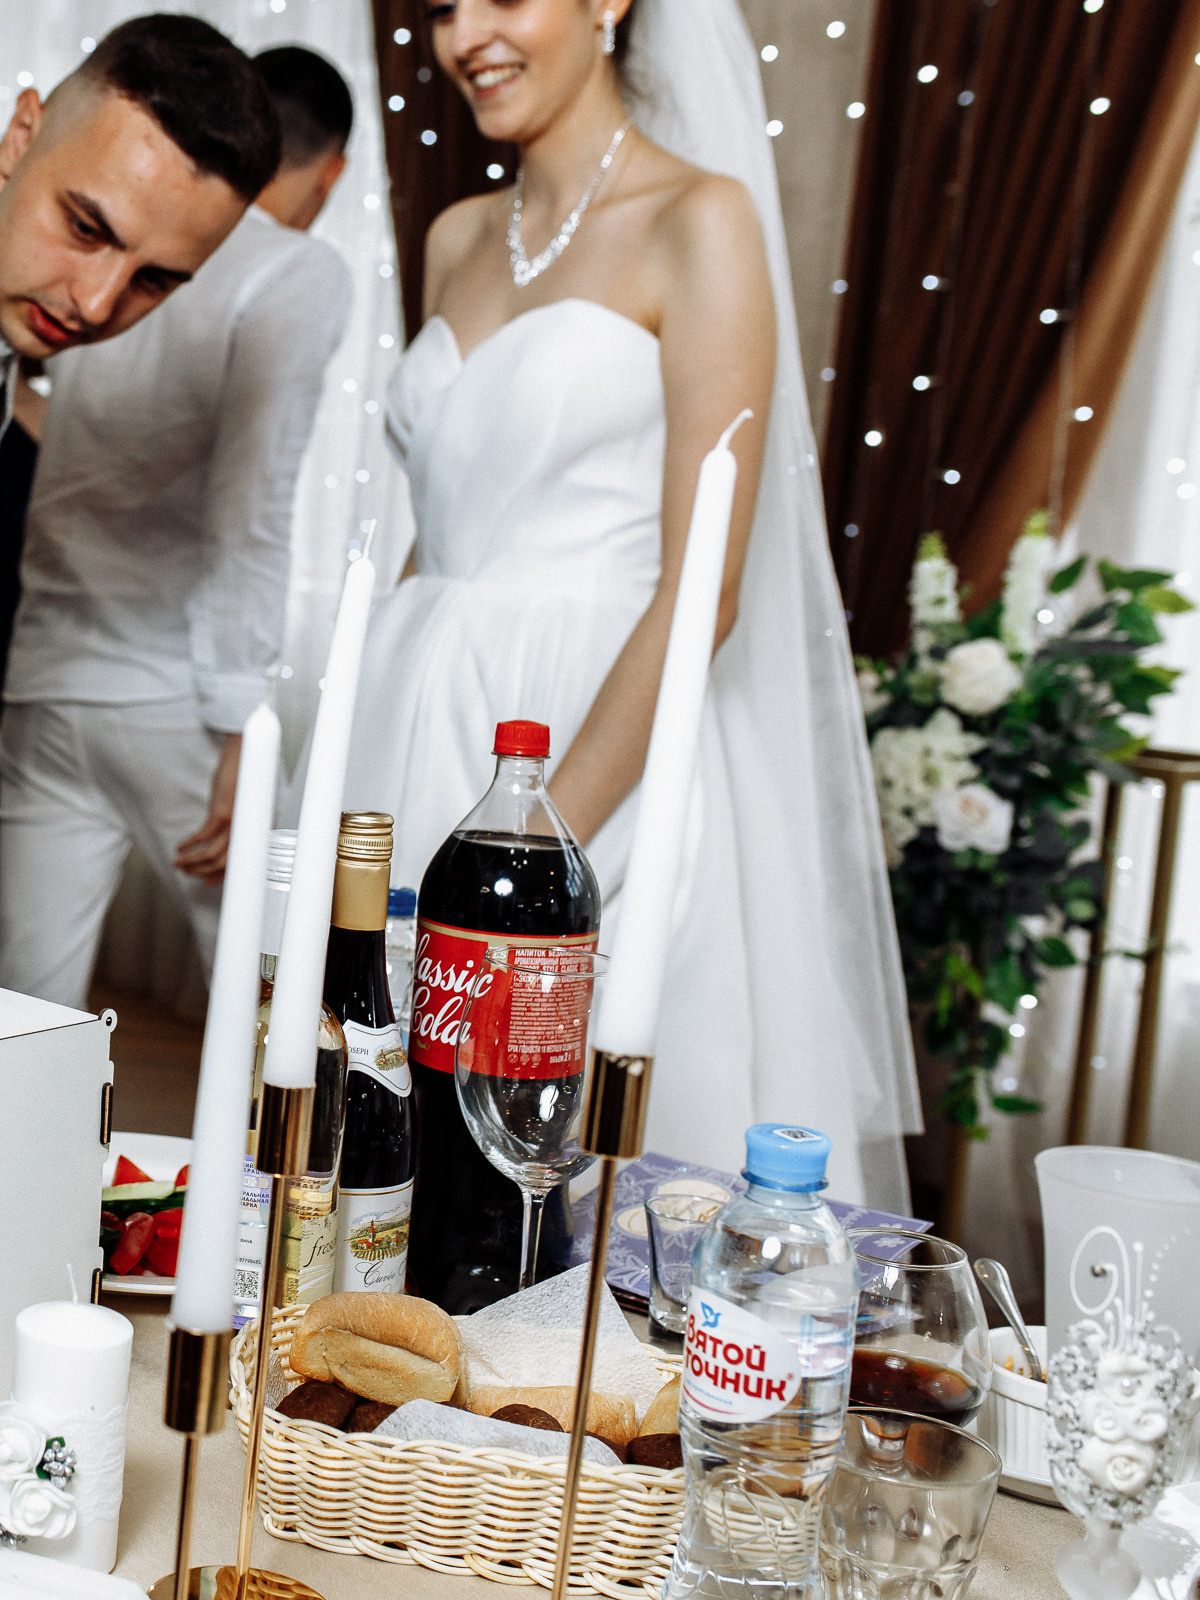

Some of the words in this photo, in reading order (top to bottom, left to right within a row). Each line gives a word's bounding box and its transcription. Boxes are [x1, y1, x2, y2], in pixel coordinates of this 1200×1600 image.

[414, 930, 494, 999] lassic
[515, 949, 546, 957] НАПИТОК
[411, 986, 472, 1047] Cola
[348, 1046, 369, 1055] OSEPH
[242, 1190, 270, 1198] РАЛЬНАЯ
[687, 1314, 766, 1371] ВЯТОЙ
[685, 1346, 787, 1401] ТОЧНИК
